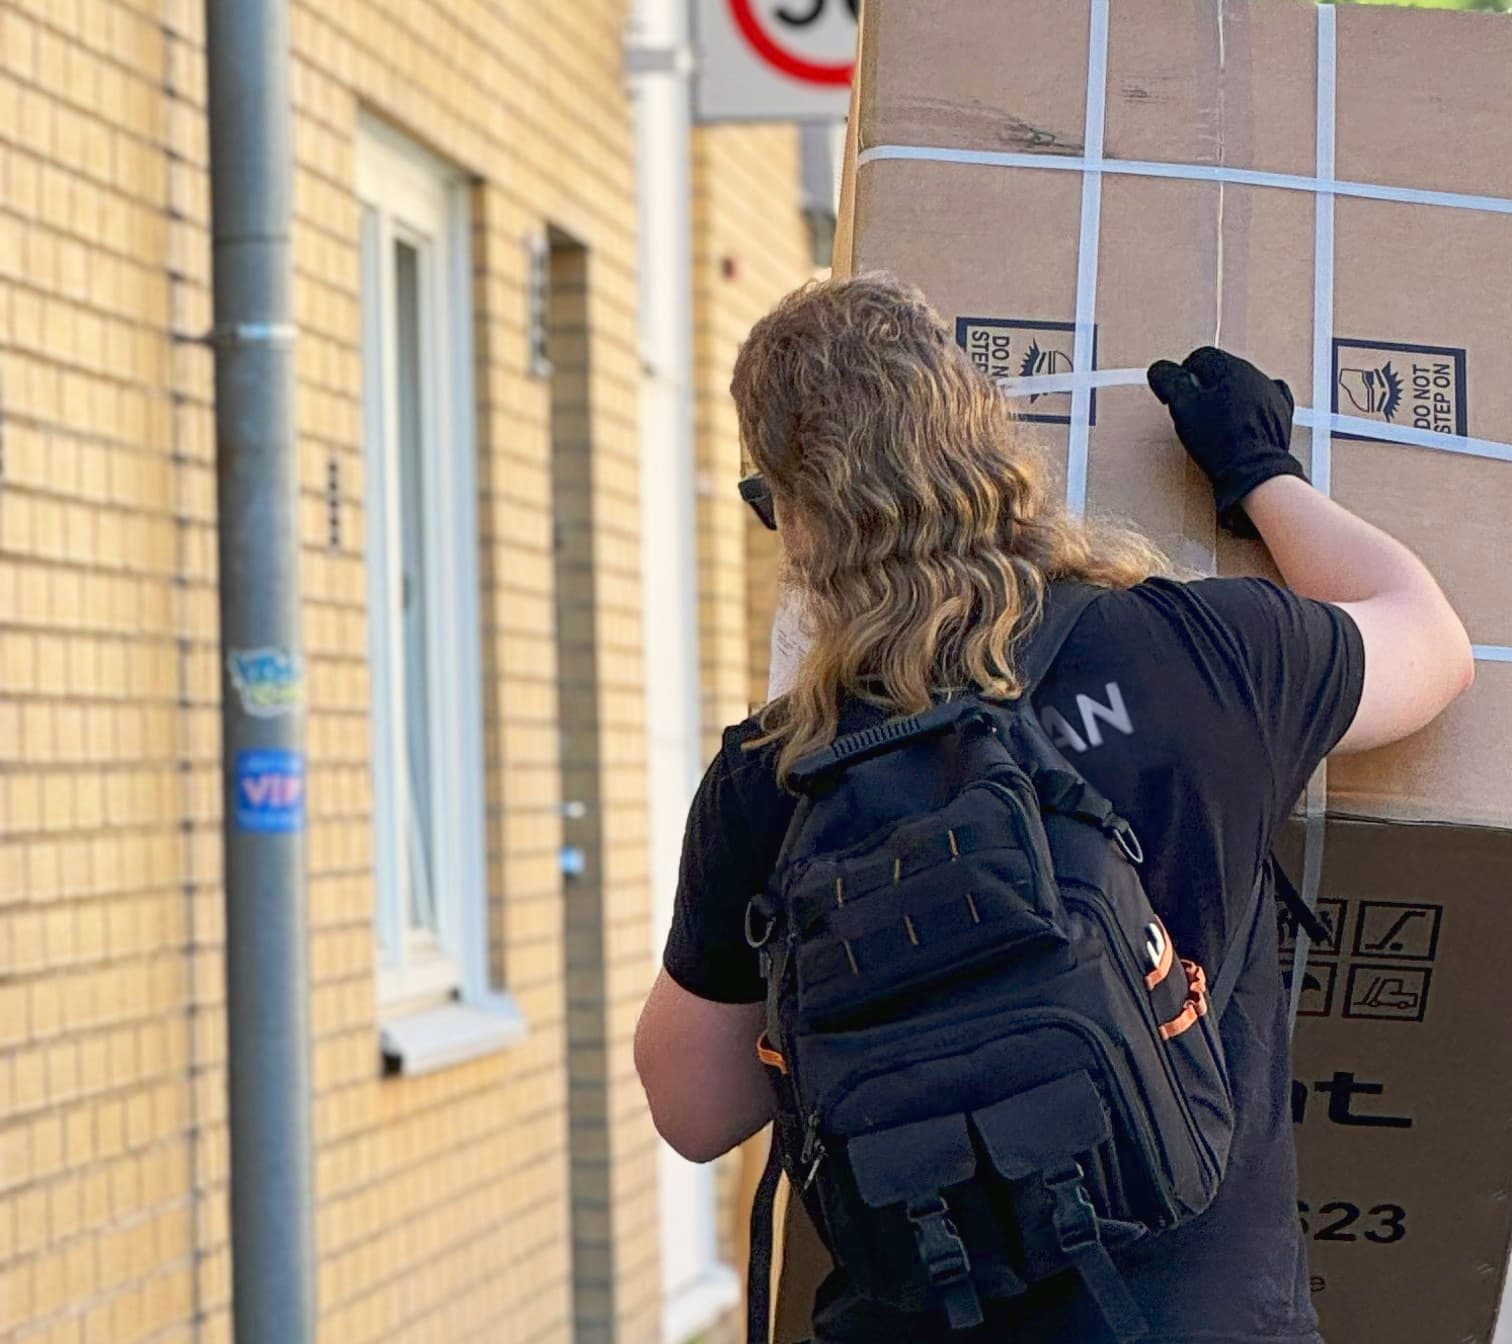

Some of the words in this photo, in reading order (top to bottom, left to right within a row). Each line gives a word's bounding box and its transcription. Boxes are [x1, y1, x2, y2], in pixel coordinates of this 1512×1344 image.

[992, 336, 1010, 360] DO
[1412, 364, 1431, 399] NOT
[1433, 363, 1451, 389] ON
[1414, 405, 1431, 430] DO
[1434, 392, 1451, 434] STEP
